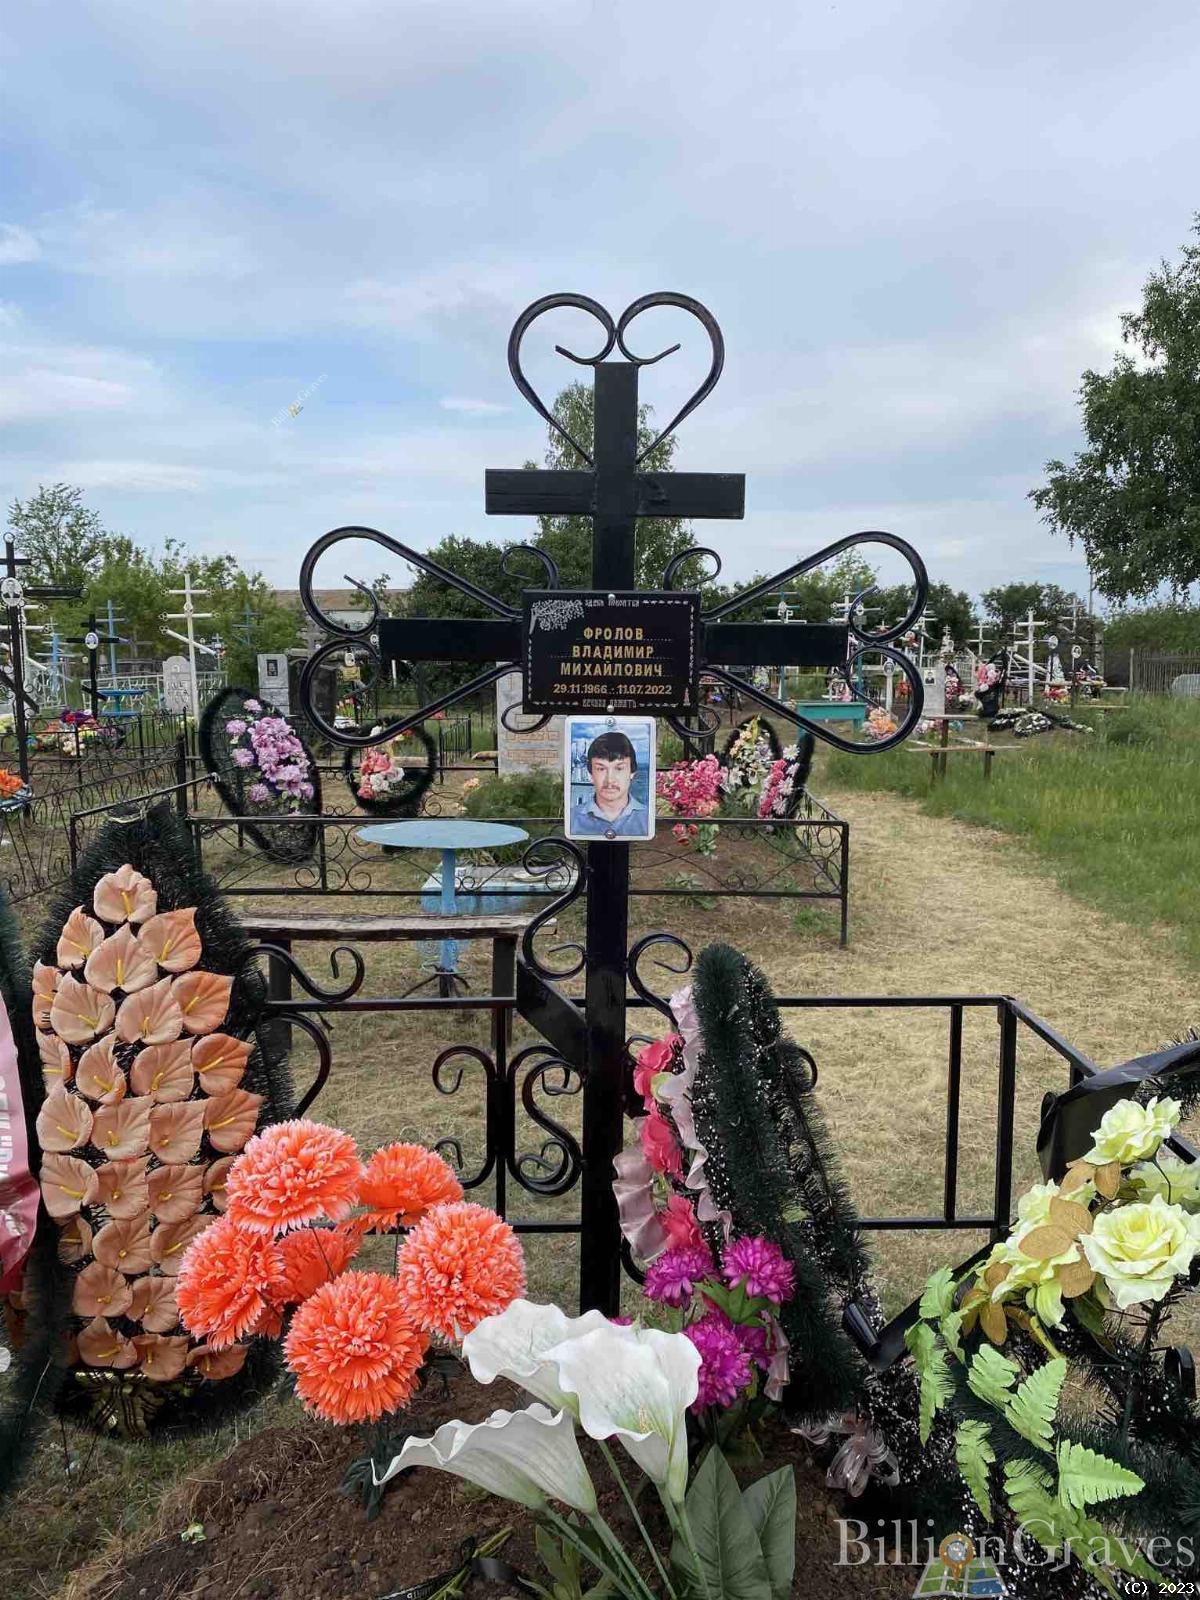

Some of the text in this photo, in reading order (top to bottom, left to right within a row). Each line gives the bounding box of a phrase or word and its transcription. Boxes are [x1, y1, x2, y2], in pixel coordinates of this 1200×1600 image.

[583, 627, 644, 640] ФРОЛОВ
[572, 645, 654, 660] ВЛАДИМИР
[560, 661, 663, 676] МИХАЙЛОВИЧ
[553, 683, 607, 695] 29.11.1966
[617, 684, 673, 695] 11.07.2022
